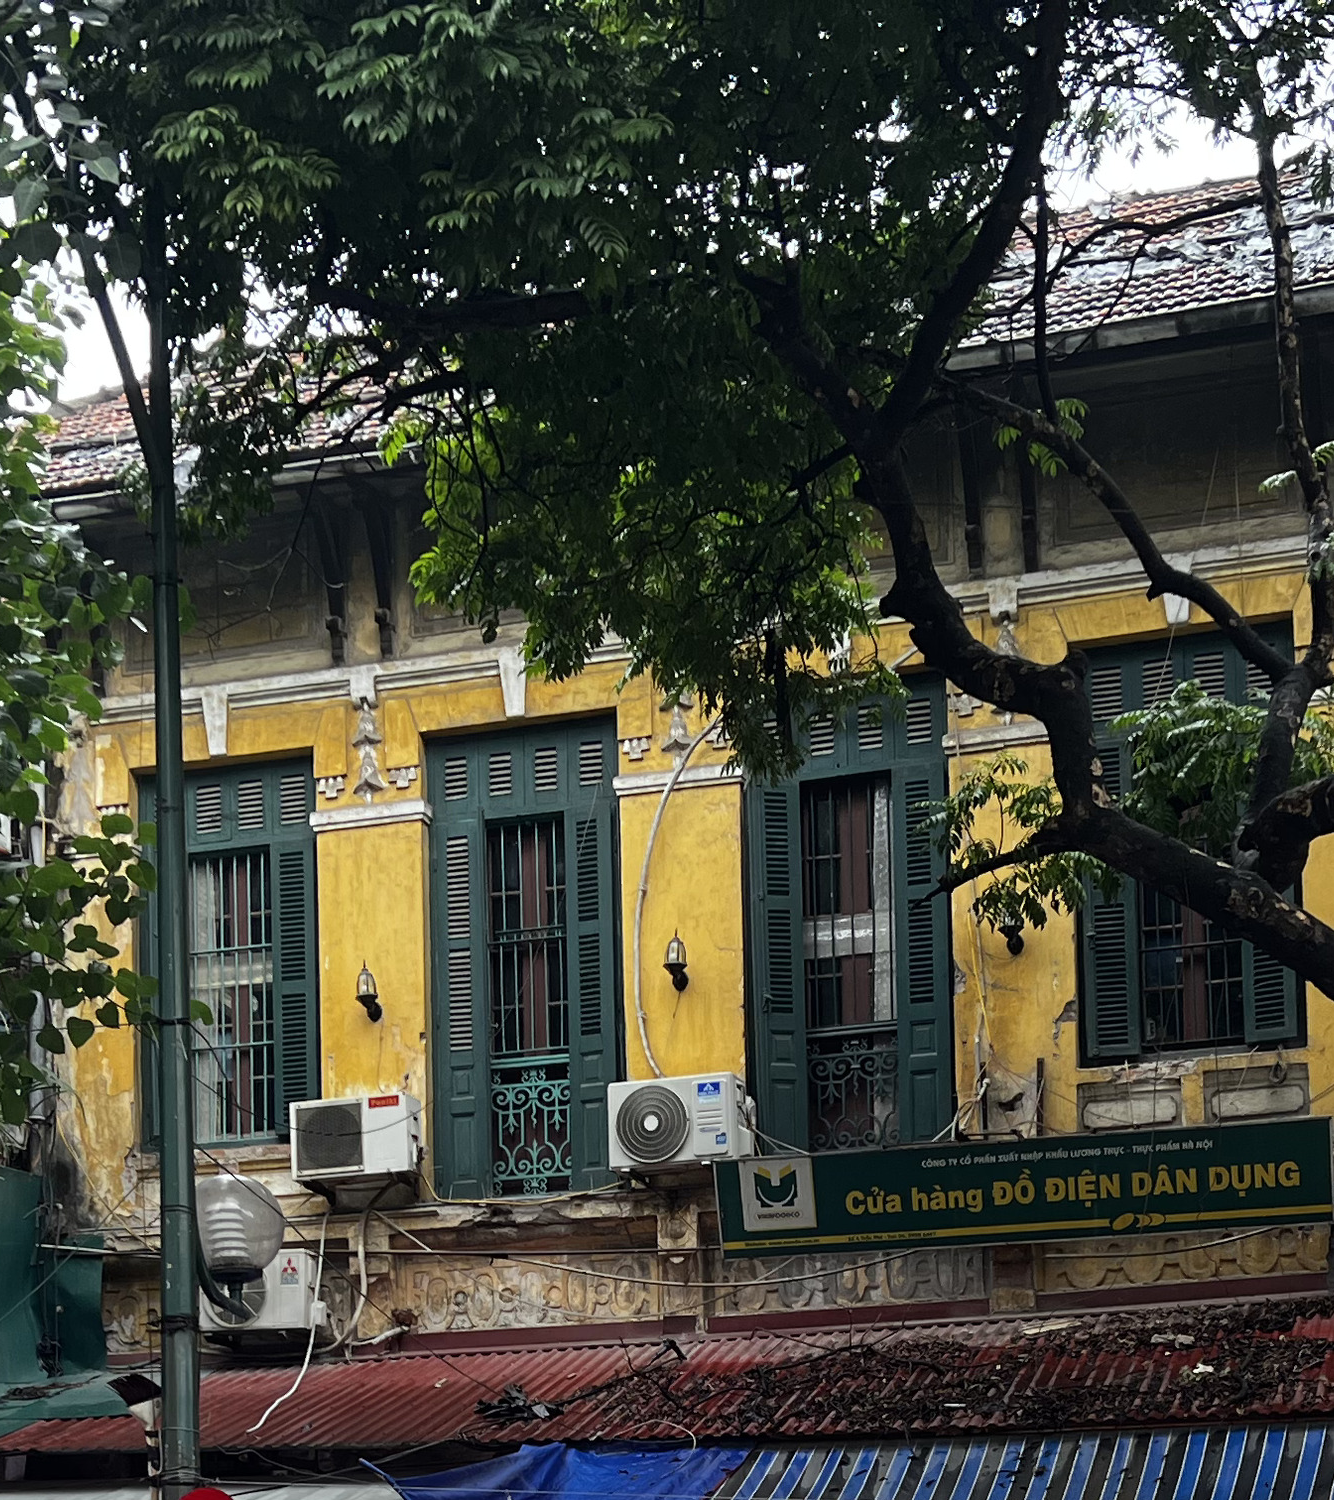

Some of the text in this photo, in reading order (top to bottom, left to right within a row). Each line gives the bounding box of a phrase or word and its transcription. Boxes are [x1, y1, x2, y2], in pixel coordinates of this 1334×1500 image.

[845, 1160, 1301, 1215] Cửa hàng ĐỒ ĐIỆN DÂN DỤNG
